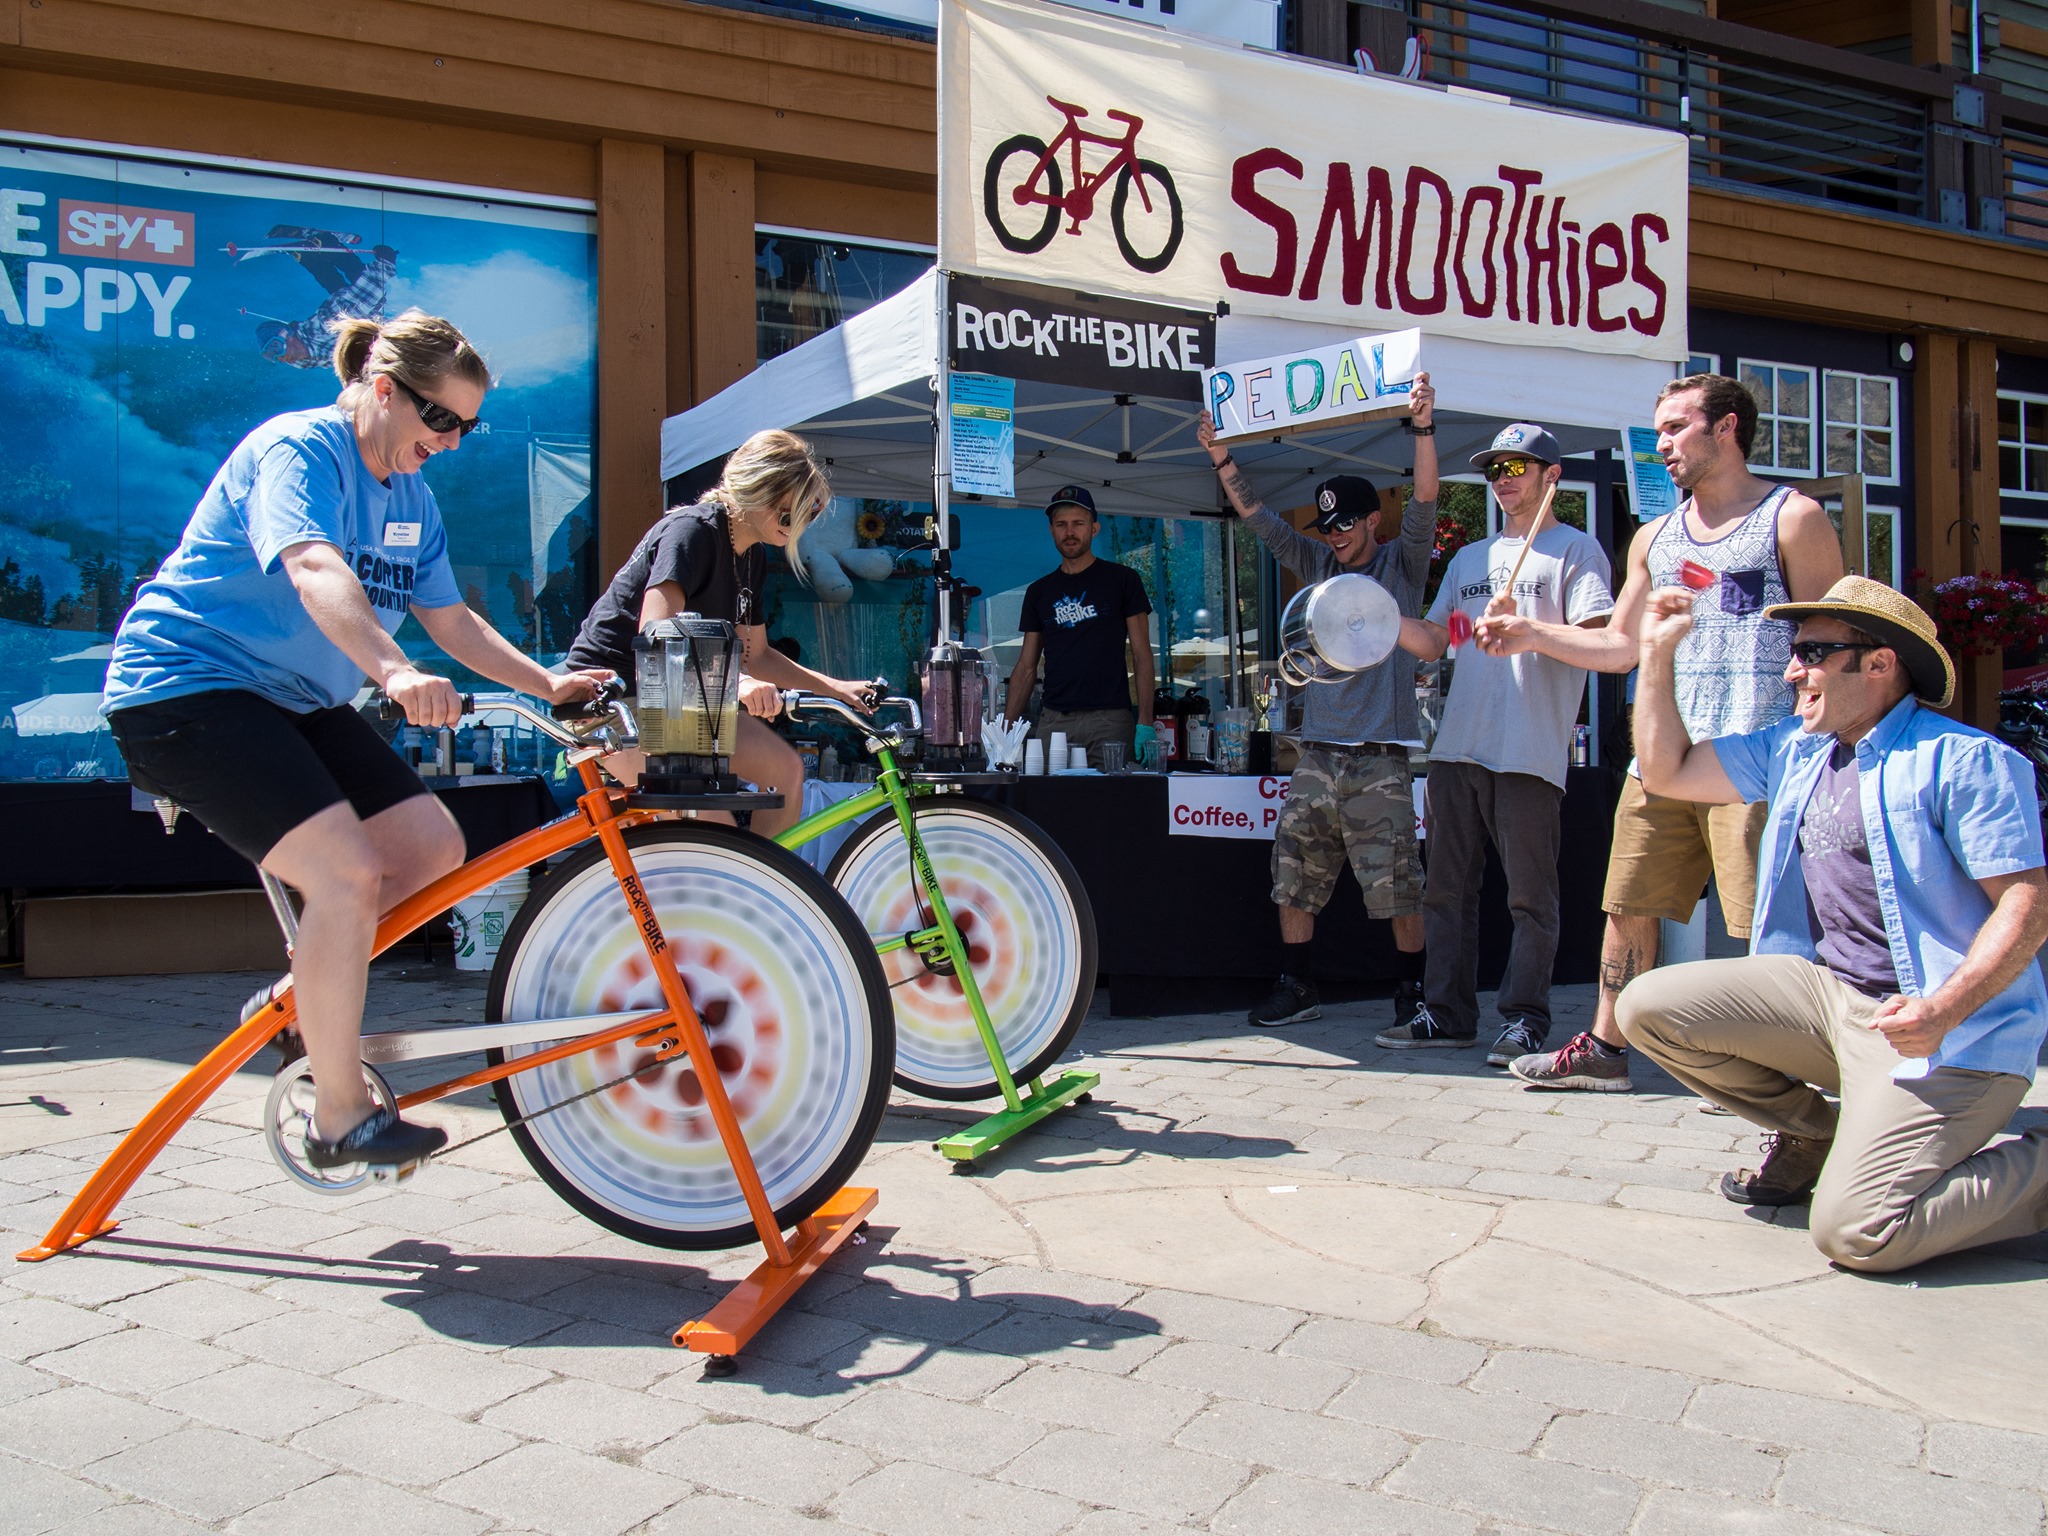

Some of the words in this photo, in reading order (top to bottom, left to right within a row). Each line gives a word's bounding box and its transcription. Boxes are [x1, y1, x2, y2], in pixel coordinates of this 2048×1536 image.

[956, 302, 1059, 357] ROCK
[1051, 313, 1104, 345] THE
[1103, 320, 1205, 371] BIKE
[1209, 342, 1414, 432] PEDAL
[1069, 604, 1098, 623] BIKE
[1173, 804, 1255, 831] Coffee,
[621, 874, 644, 909] ROCK
[921, 867, 939, 893] BIKE
[639, 902, 653, 920] THE
[642, 918, 667, 955] BIKE
